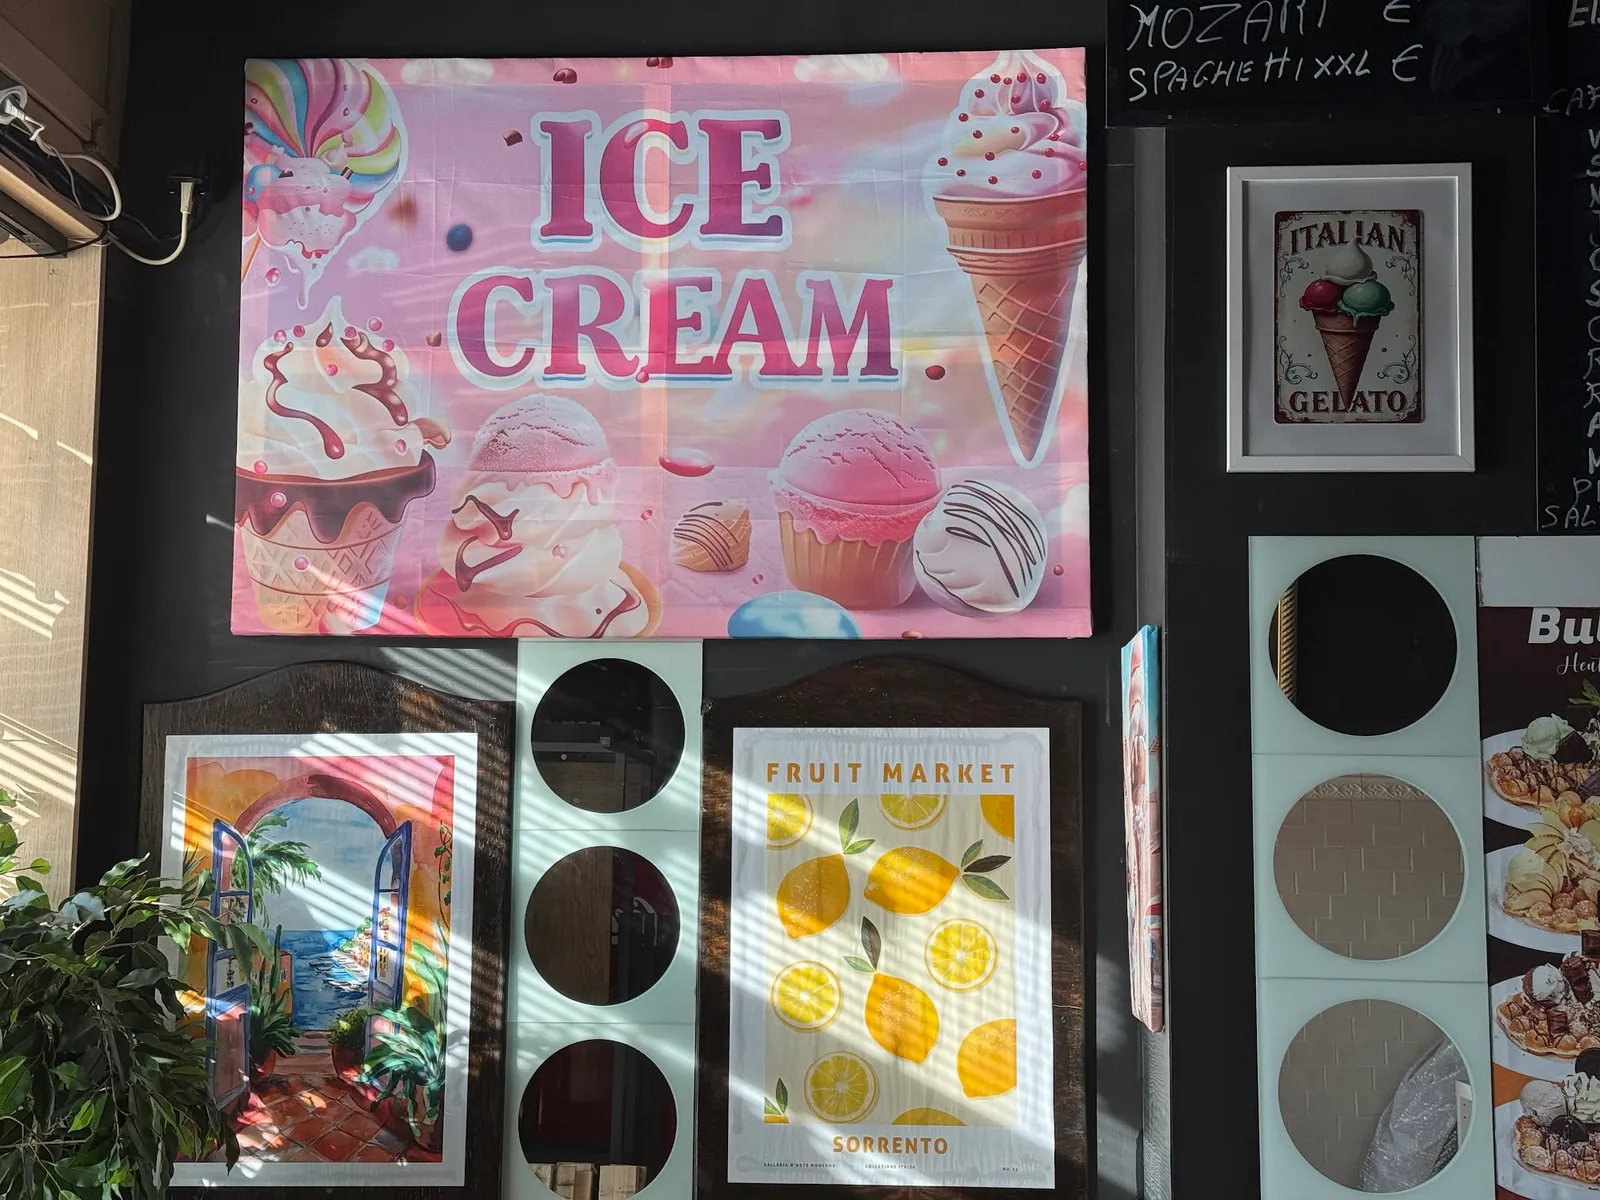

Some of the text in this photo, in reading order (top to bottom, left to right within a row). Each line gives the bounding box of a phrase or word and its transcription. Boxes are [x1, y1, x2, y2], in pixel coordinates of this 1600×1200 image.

[1312, 49, 1372, 80] XXL
[535, 115, 788, 246] ICE
[1289, 219, 1407, 256] ITALIAN
[453, 272, 902, 385] CREAM
[1288, 390, 1409, 414] GELATO
[766, 762, 1015, 784] FRUIT MARKET
[832, 1135, 949, 1155] SORRENTO
